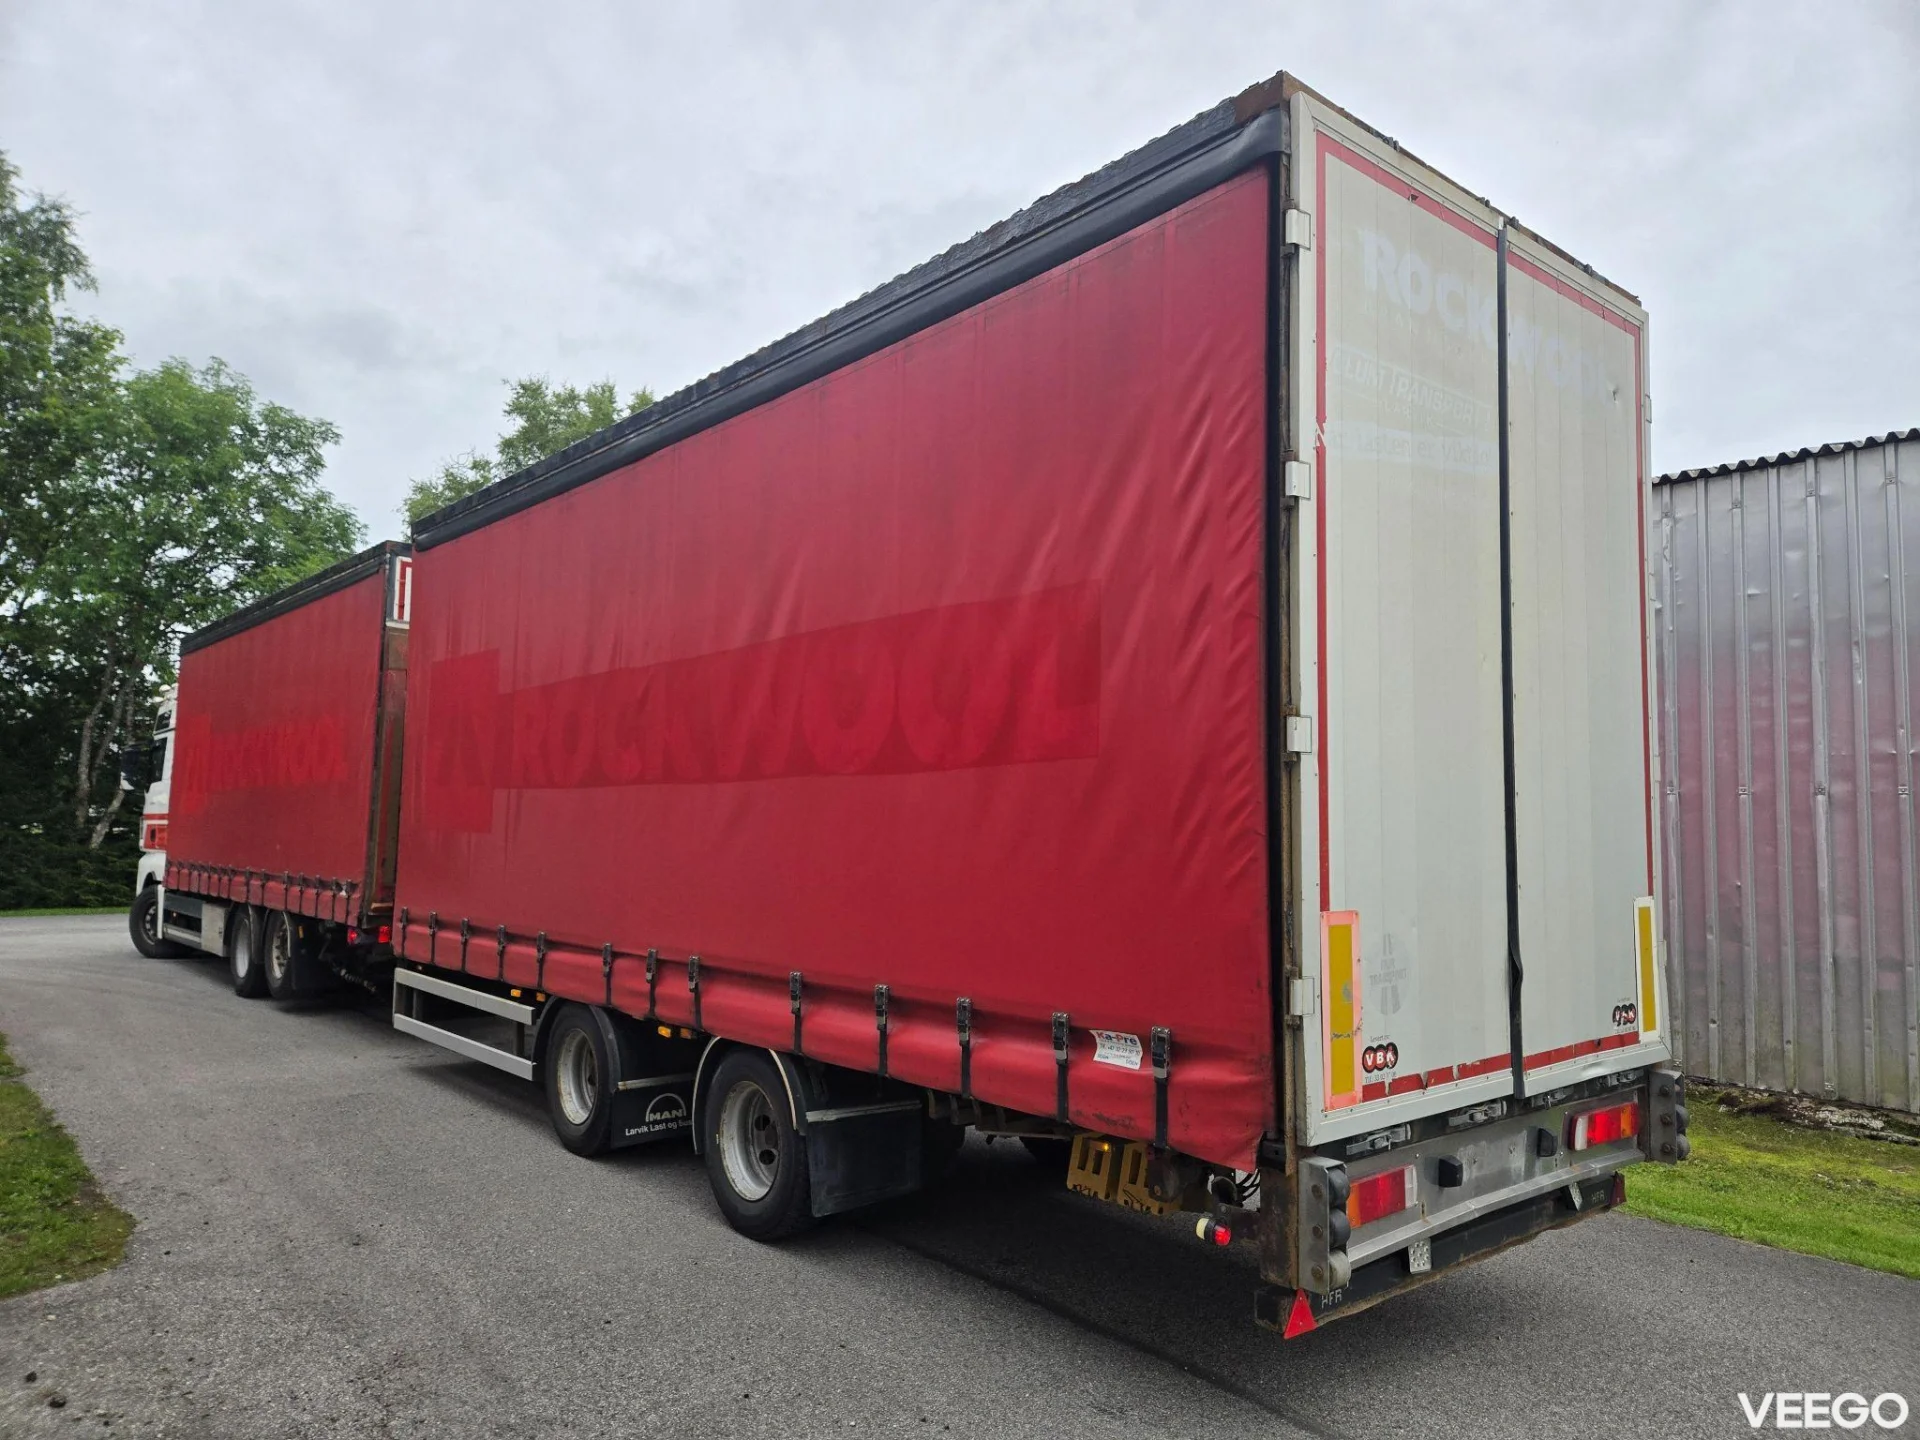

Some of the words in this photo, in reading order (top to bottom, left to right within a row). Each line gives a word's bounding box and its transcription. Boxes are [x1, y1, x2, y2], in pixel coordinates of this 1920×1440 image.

[649, 1108, 683, 1122] MAN
[625, 1126, 649, 1136] Larvik
[650, 1122, 667, 1132] Last
[667, 1121, 678, 1130] og
